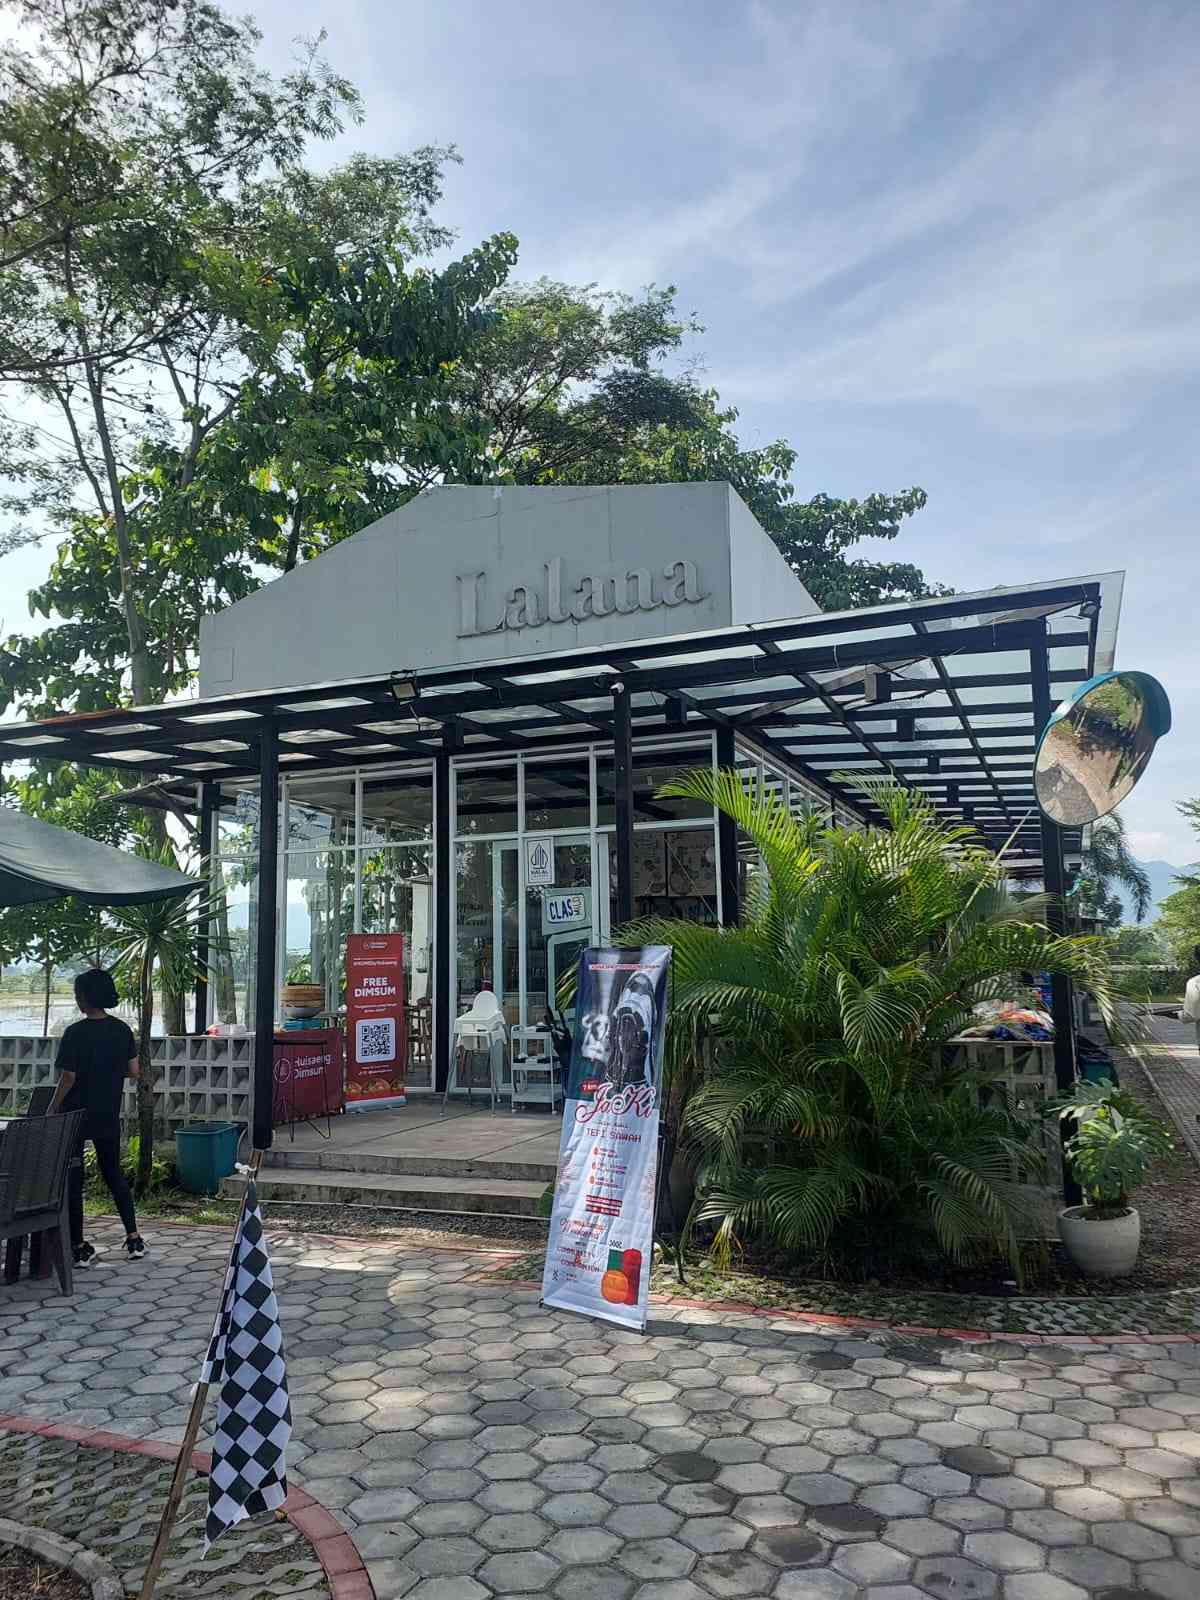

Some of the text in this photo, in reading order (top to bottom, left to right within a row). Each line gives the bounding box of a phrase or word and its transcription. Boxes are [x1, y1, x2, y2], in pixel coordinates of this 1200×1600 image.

[456, 556, 709, 639] Lalana
[550, 898, 573, 920] CLAS
[363, 977, 388, 987] FREE
[354, 987, 396, 997] DIMSUM
